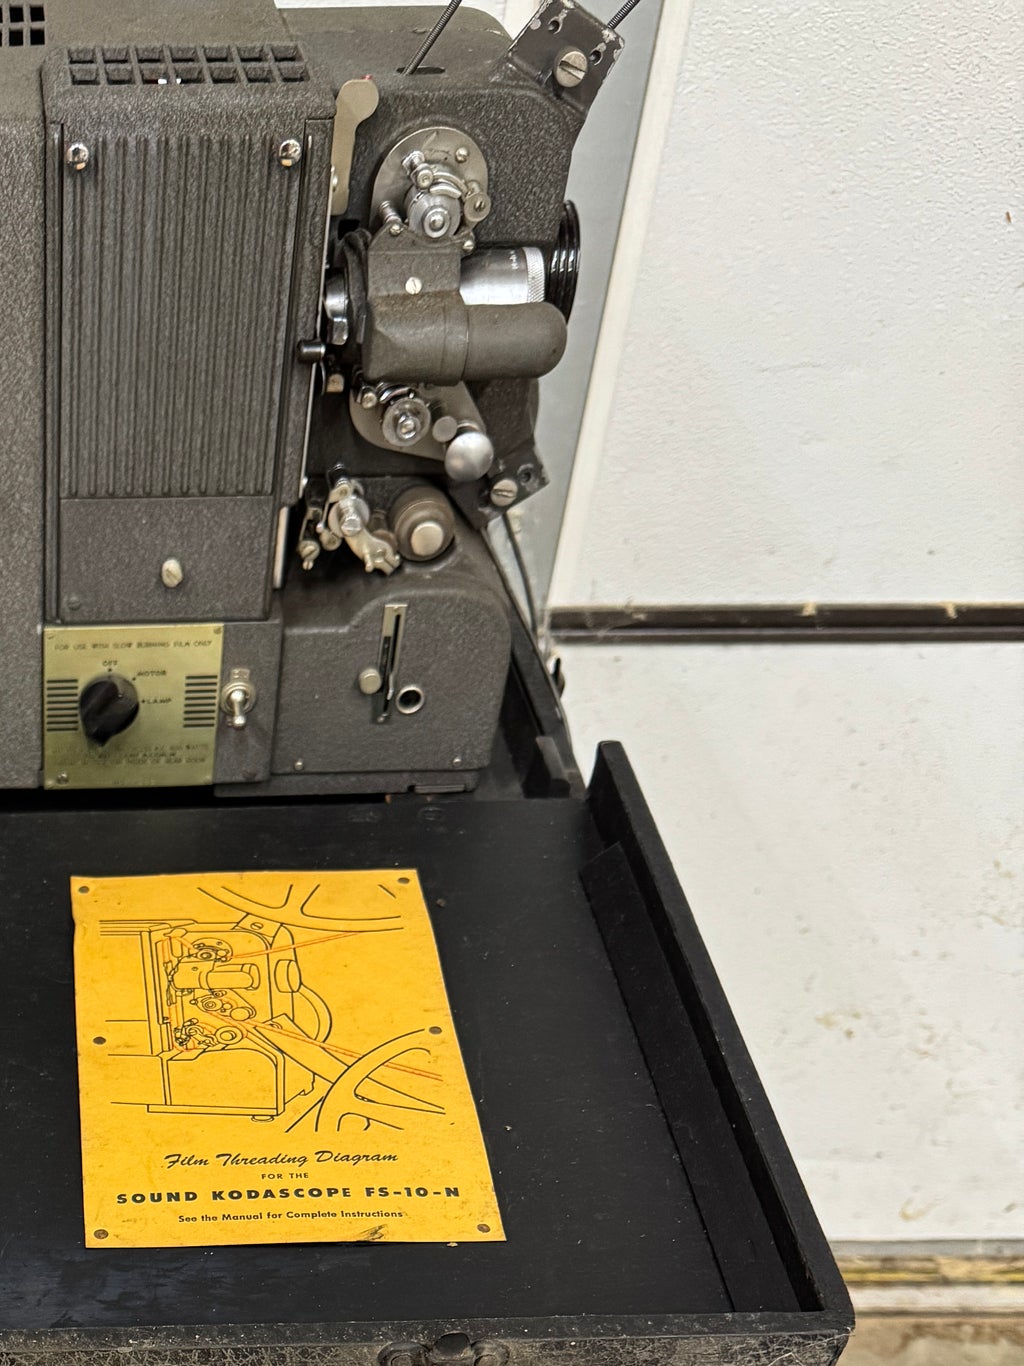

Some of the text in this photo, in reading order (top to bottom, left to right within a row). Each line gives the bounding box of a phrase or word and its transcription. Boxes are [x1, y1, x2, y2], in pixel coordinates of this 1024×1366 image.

[164, 1149, 398, 1169] Film Threading Diagram
[116, 1186, 460, 1204] SOUND KODASCOPE FS-10-N
[178, 1209, 403, 1223] See the Manual for Complete Instructions
